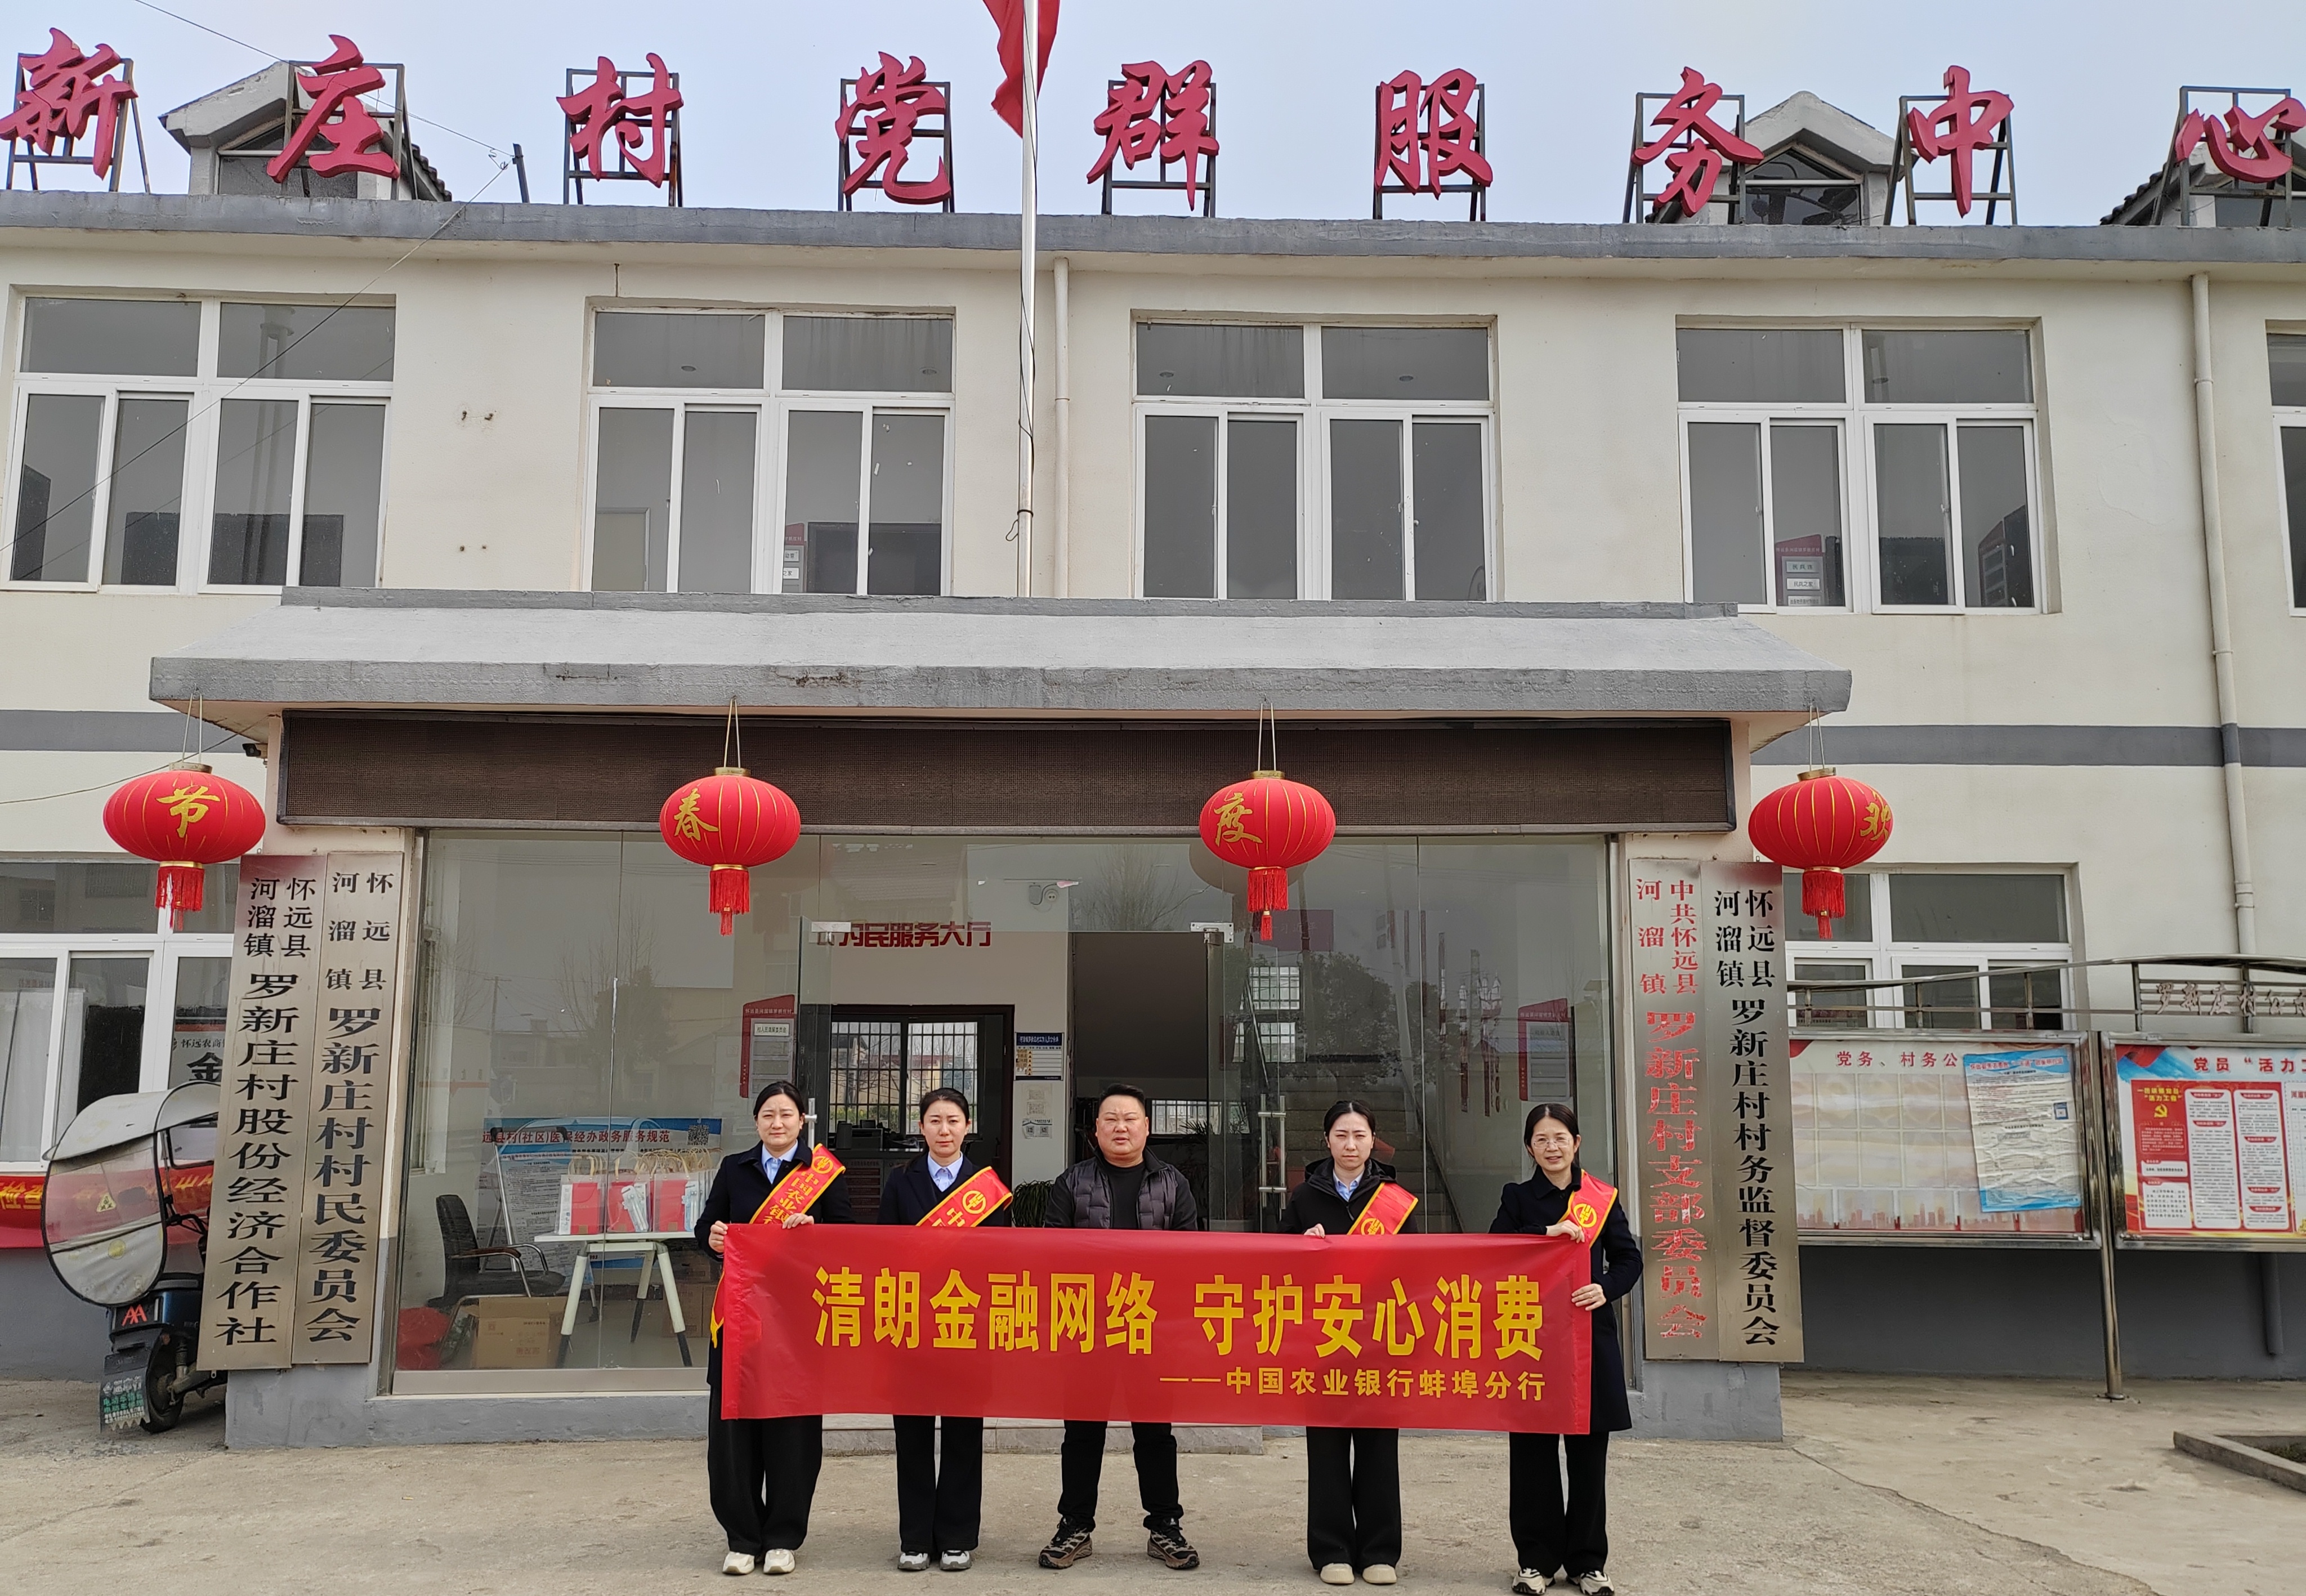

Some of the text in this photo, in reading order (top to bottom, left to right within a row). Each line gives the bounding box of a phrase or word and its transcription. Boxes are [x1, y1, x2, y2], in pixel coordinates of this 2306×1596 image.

[0, 28, 2306, 218] 新庄村党群服务中心
[156, 785, 221, 838] 节
[673, 788, 719, 841] 春
[1213, 792, 1263, 847] 度
[243, 877, 281, 958] 河溜镇
[280, 877, 316, 958] 怀远县
[324, 872, 360, 991] 河溜镇
[357, 872, 395, 991] 怀远县
[817, 922, 991, 947] 为民服务大厅
[1635, 878, 1668, 995] 河溜镇
[1669, 879, 1699, 995] 中共怀远县
[1714, 889, 1745, 988] 河溜镇
[1745, 889, 1776, 988] 怀远县
[181, 1039, 225, 1048] 怀远农商
[213, 972, 300, 1346] 罗新庄村股份经济合作社
[303, 1007, 382, 1343] 罗新庄村村民委员会
[1644, 1011, 1708, 1339] 罗新庄村支部委员会
[1728, 998, 1781, 1345] 罗新庄村村务监督委员会
[812, 1266, 1544, 1361] 清朗金融网络 守护安心消费
